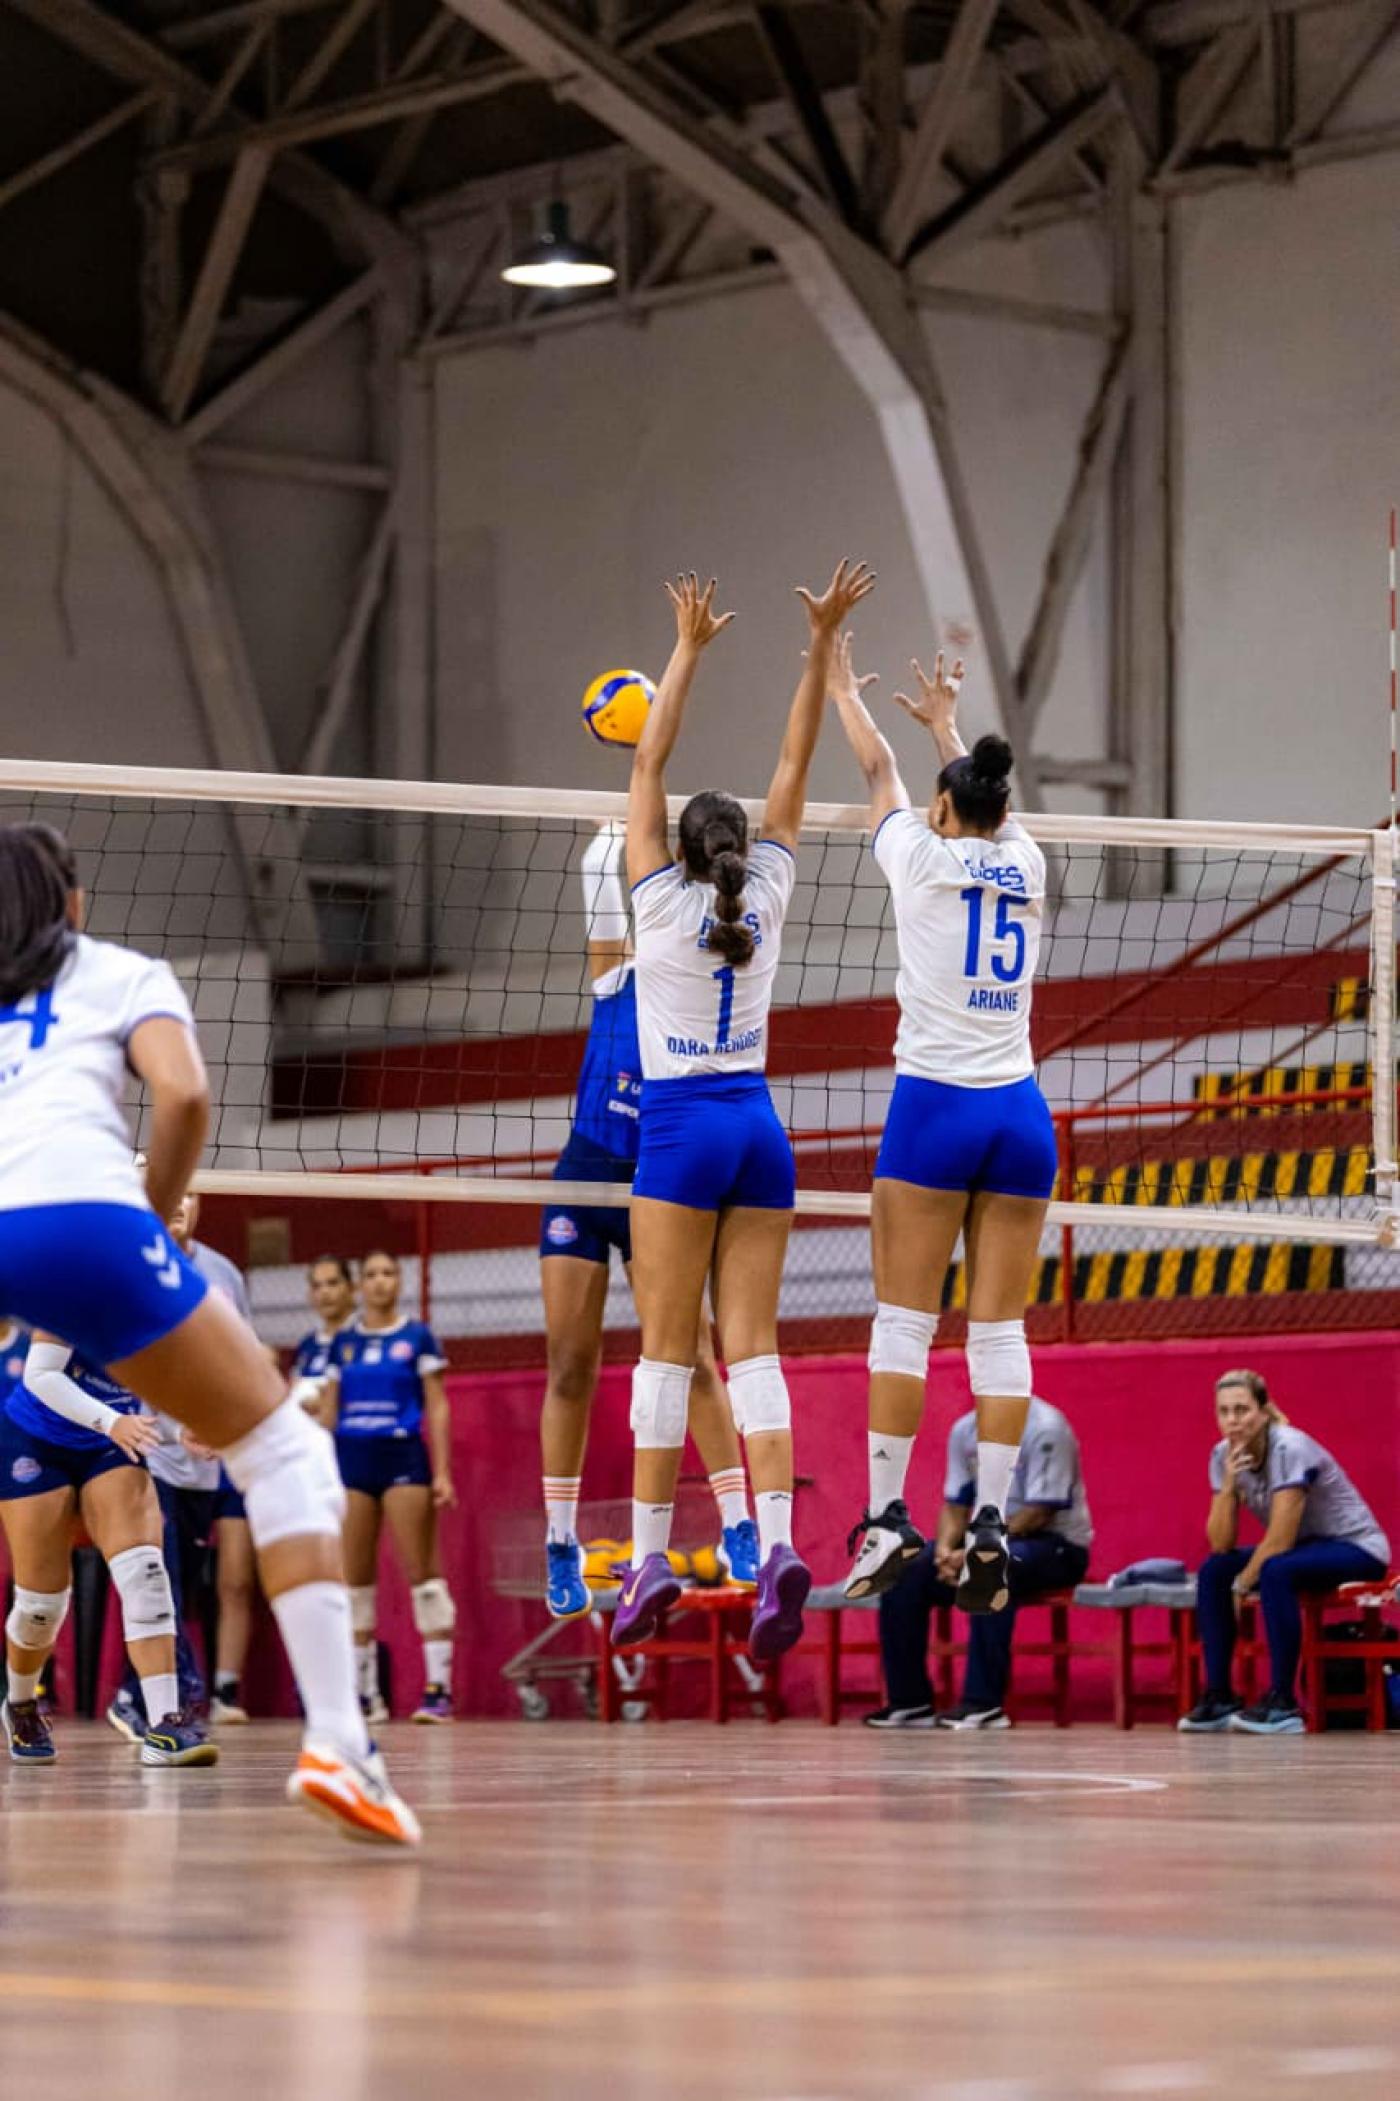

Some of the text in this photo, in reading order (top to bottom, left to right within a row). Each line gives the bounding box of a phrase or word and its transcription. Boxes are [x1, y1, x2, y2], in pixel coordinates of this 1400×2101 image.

[960, 886, 1031, 984] 15
[711, 965, 736, 1046] 1
[967, 989, 1019, 1012] ARIANE
[667, 1036, 710, 1056] DARA
